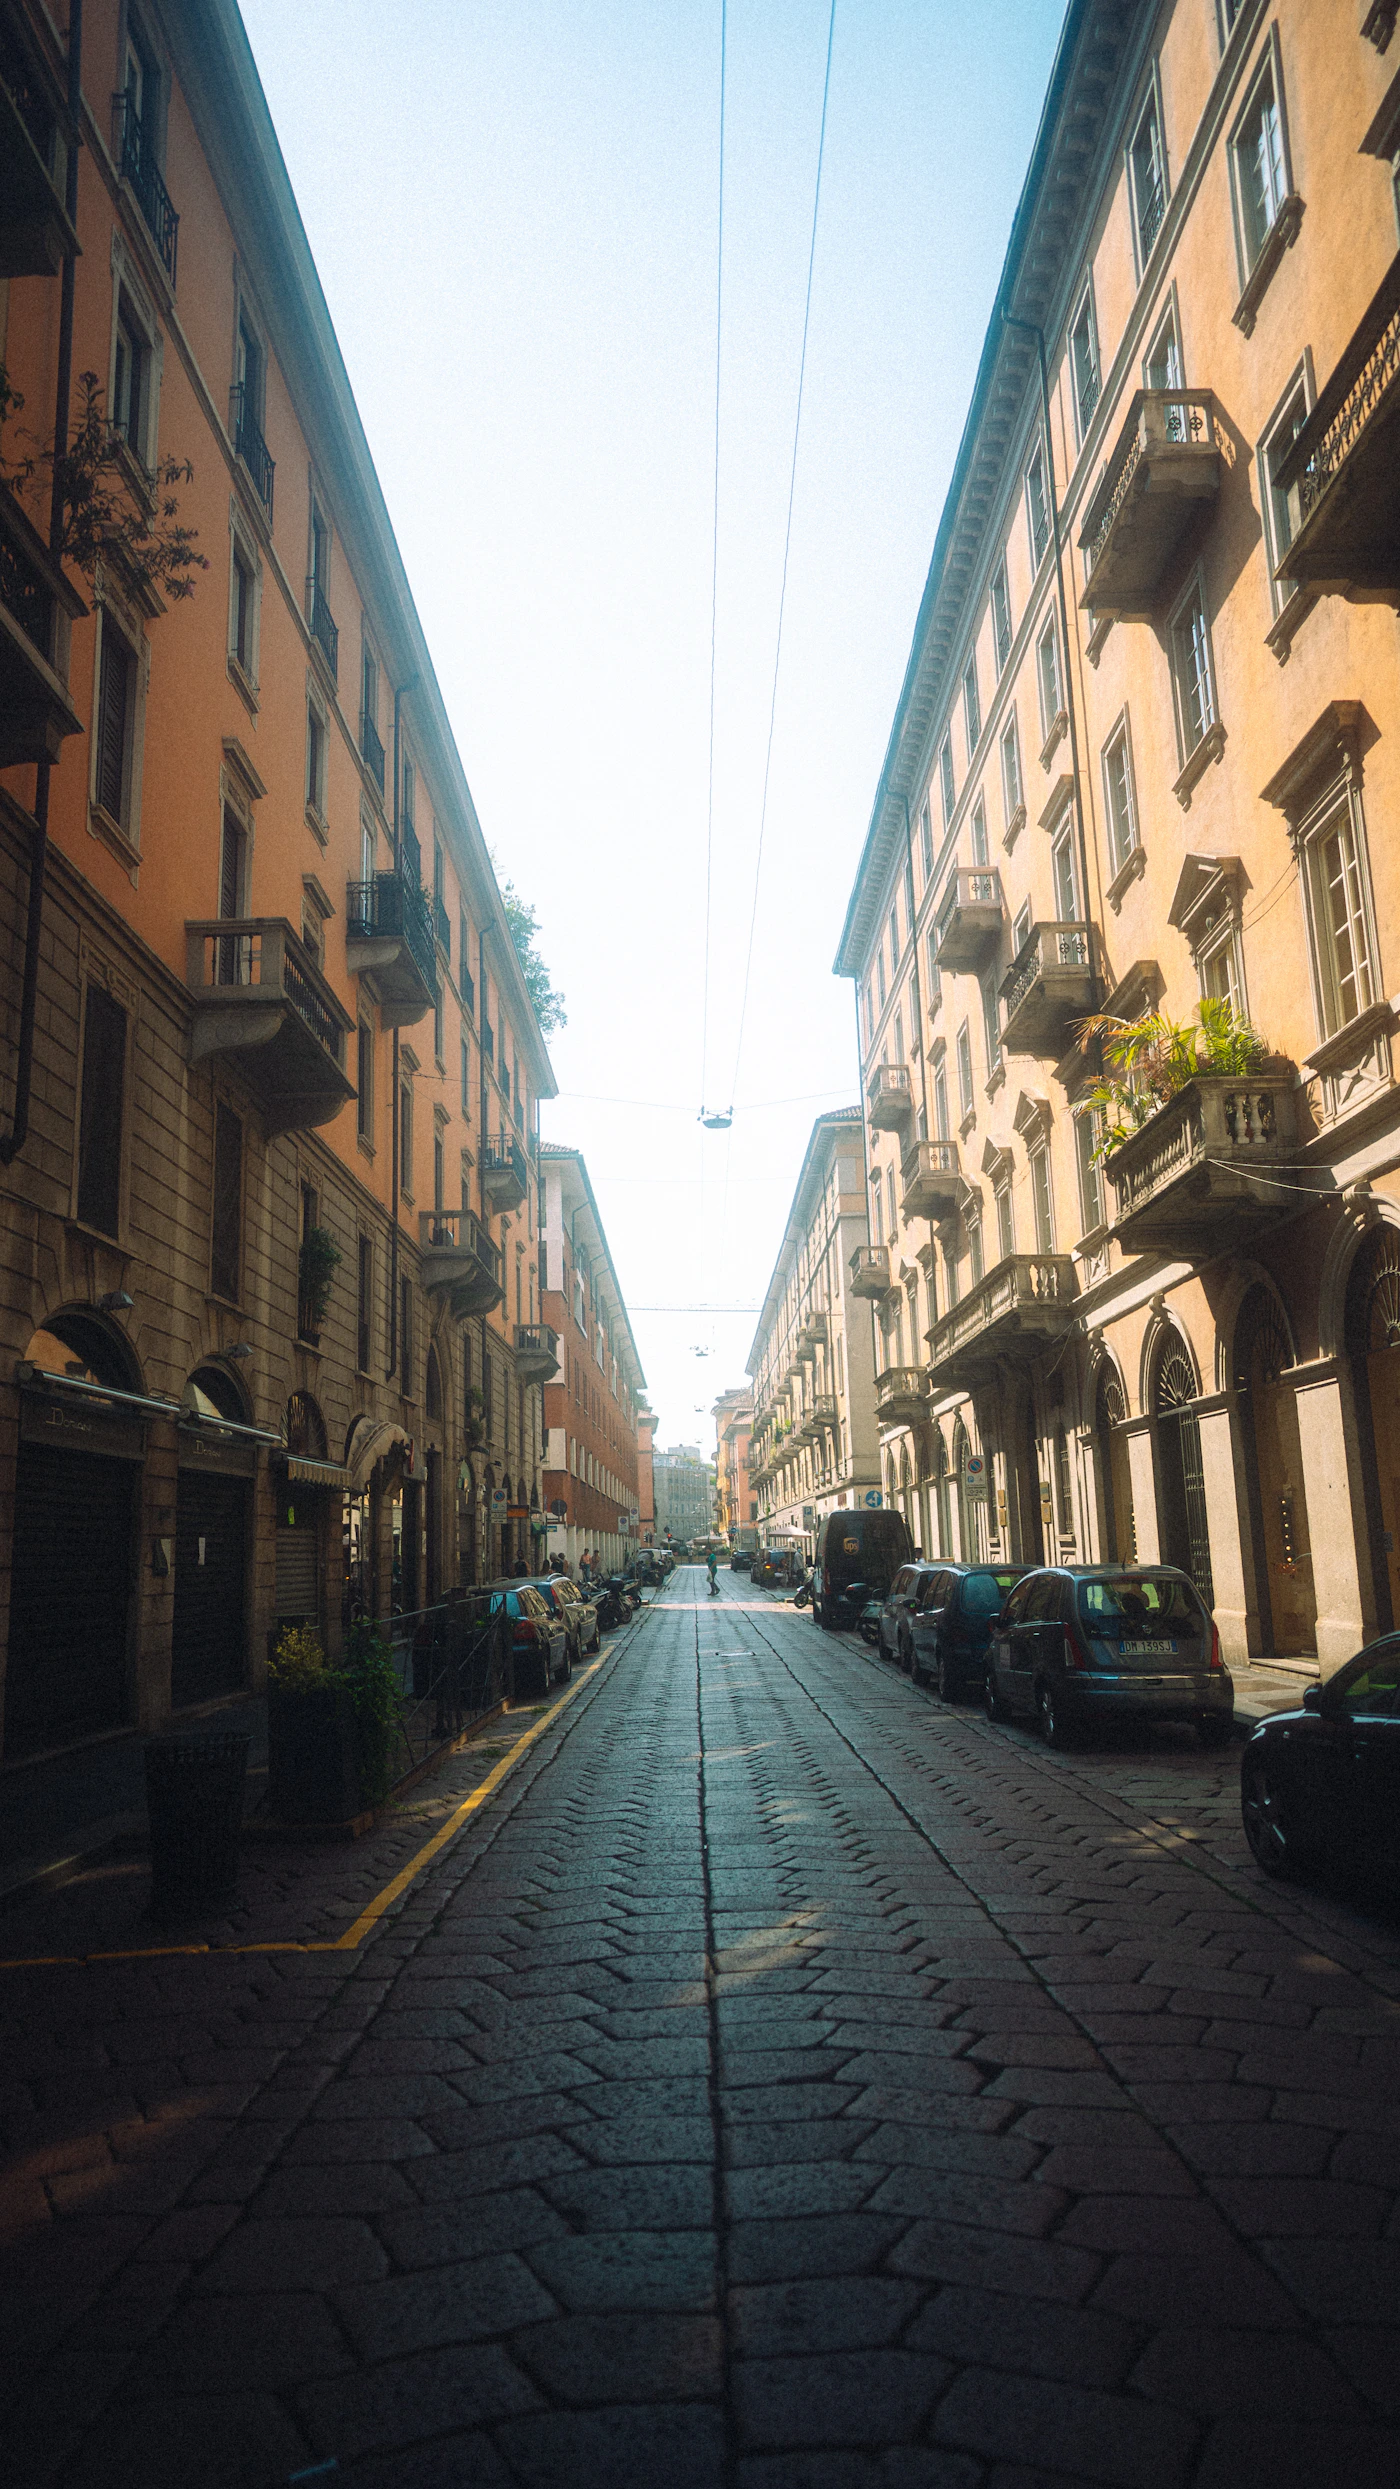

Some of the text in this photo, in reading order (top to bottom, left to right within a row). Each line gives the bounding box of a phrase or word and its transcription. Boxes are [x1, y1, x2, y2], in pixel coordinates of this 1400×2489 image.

[845, 1542, 859, 1553] ups
[1125, 1640, 1171, 1652] DM 139SJ
